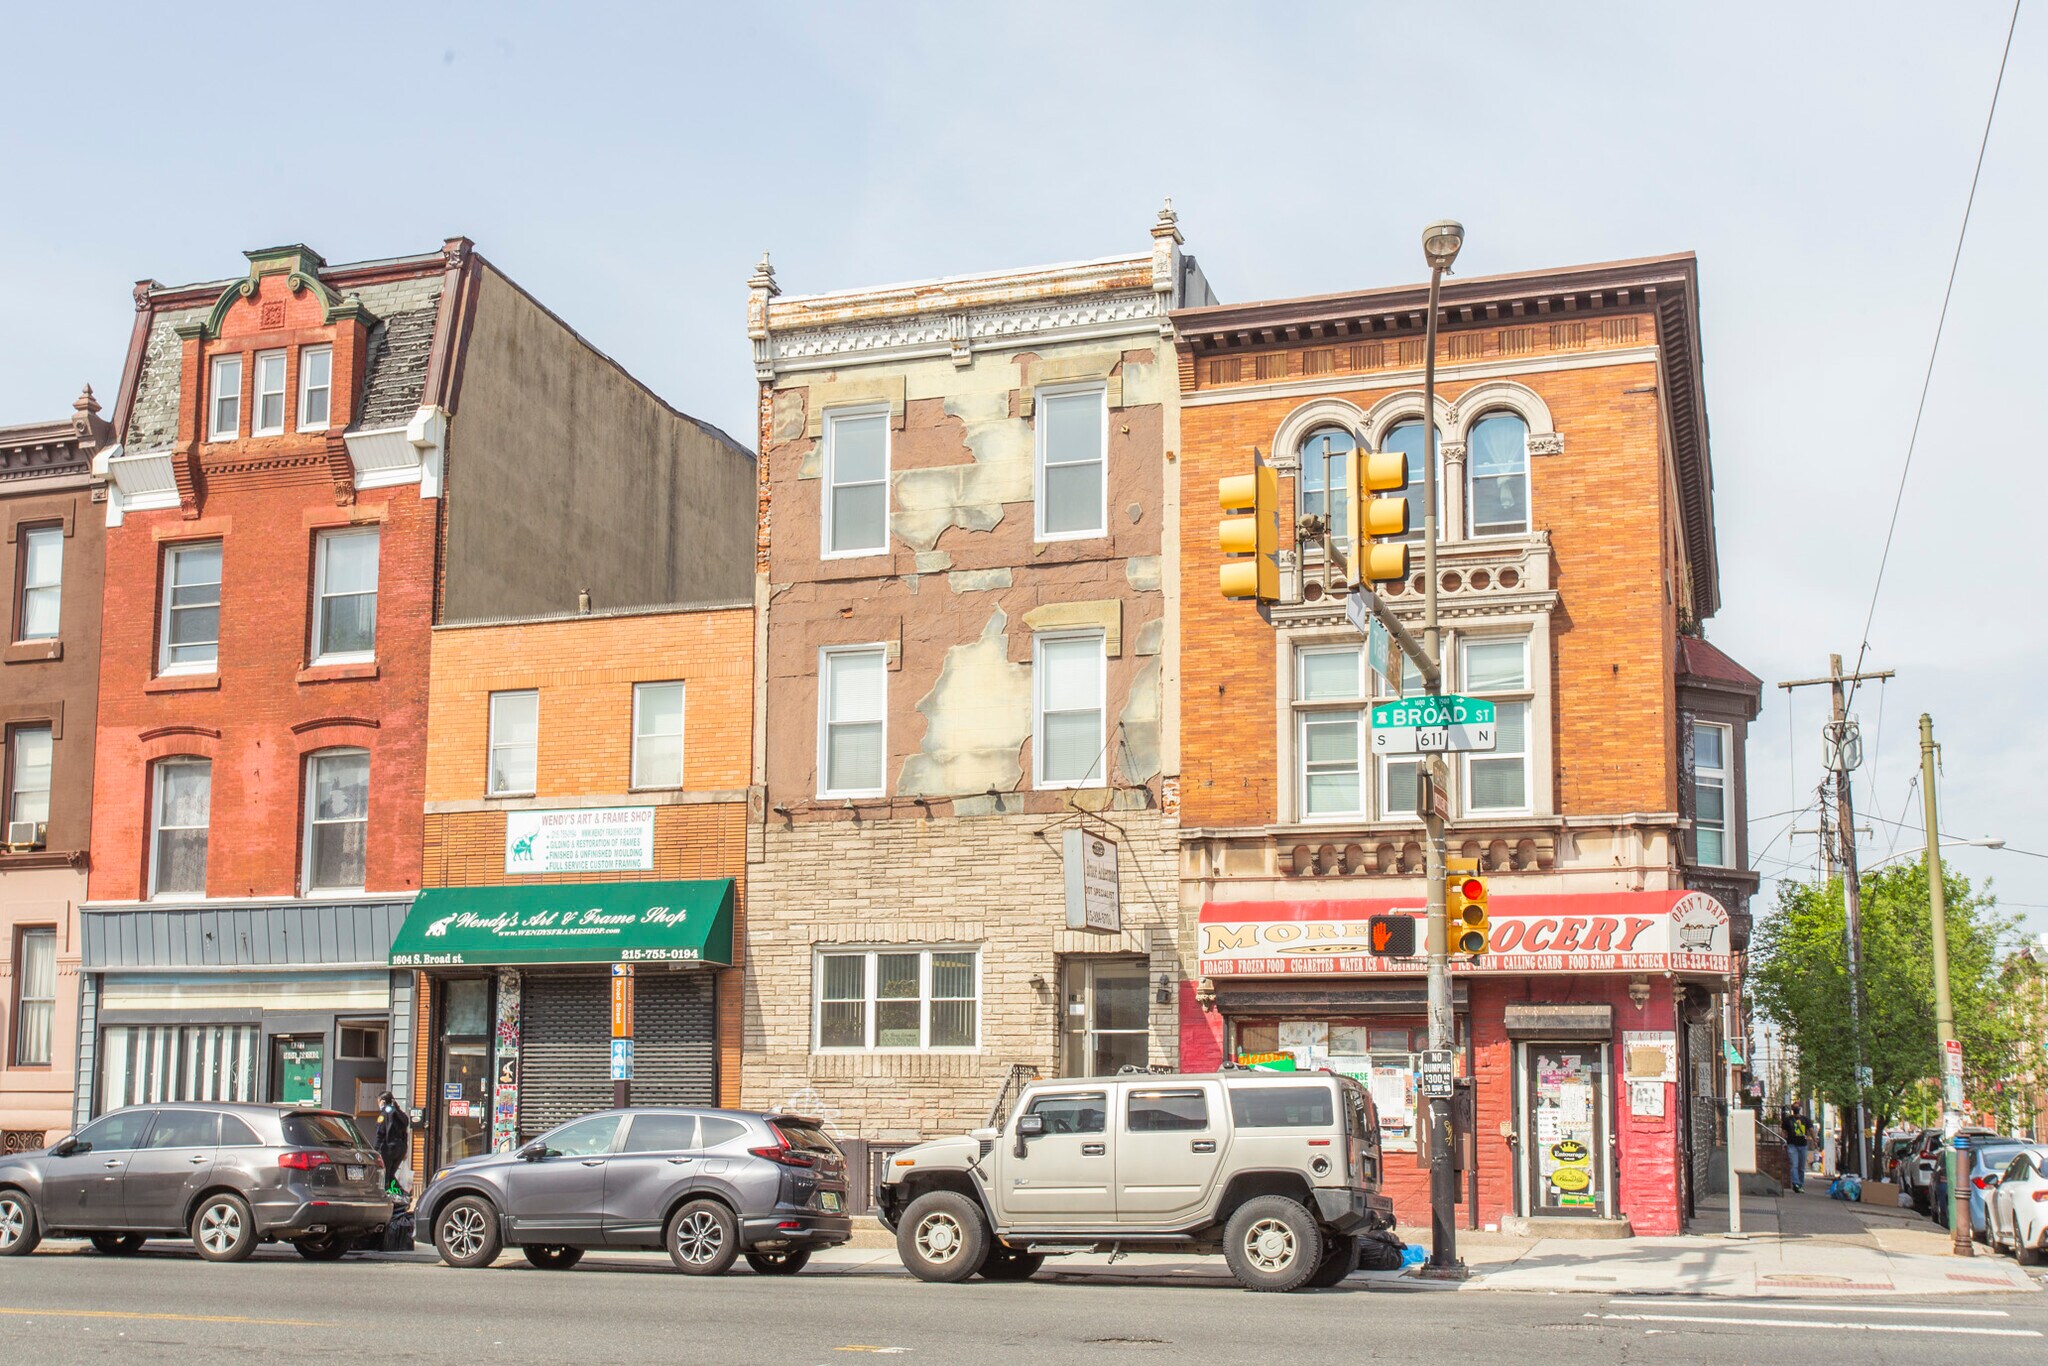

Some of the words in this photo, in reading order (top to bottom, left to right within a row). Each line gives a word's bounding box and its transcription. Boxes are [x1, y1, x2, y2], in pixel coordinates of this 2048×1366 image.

[1429, 698, 1435, 707] S
[1393, 706, 1467, 726] BROAD
[1475, 709, 1490, 722] ST
[1377, 735, 1386, 746] S
[1420, 732, 1442, 746] 611
[1479, 731, 1488, 741] N
[542, 814, 576, 826] WENDY'S
[576, 813, 593, 825] ART
[594, 813, 600, 824] &
[602, 812, 629, 824] FRAME
[630, 810, 652, 822] SHOP
[550, 841, 570, 850] GILDING
[576, 840, 611, 848] RESTORATION
[612, 839, 618, 847] OF
[620, 838, 640, 846] FRAMES
[550, 850, 574, 860] FINISHED
[580, 850, 612, 858] UNFINISHED
[614, 848, 643, 857] MOULDING
[549, 862, 563, 870] FULL
[564, 860, 588, 870] SERVICE
[590, 860, 614, 868] CUSTOM
[614, 859, 641, 868] FRAMING
[1672, 897, 1694, 923] OPEN
[1697, 896, 1703, 910] 7
[1706, 898, 1729, 926] DAYS
[456, 912, 519, 933] Wendy's
[522, 910, 559, 927] Art
[561, 912, 578, 926] &
[579, 908, 636, 925] Frame
[640, 906, 687, 928] Shop
[498, 927, 620, 936] www.WENDYSFRAMESHOP.com
[1424, 916, 1654, 953] OCERY
[392, 955, 412, 965] 1604
[413, 954, 422, 964] S.
[424, 954, 450, 964] Broad
[452, 953, 464, 964] st.
[621, 949, 698, 960] 215-755-0194
[1204, 960, 1234, 974] HOAGIES
[1238, 959, 1266, 974] FROZEN
[1266, 958, 1285, 973] FOOD
[1290, 958, 1334, 973] CIGARETTES
[1339, 958, 1364, 972] WATER
[1365, 957, 1378, 972] ICE
[1504, 956, 1536, 970] CALLING
[1538, 954, 1562, 970] CARDS
[1568, 954, 1589, 969] FOOD
[1590, 954, 1616, 969] STAMP
[1622, 954, 1638, 968] WIC
[1639, 953, 1664, 968] CHECK
[1672, 953, 1730, 972] 215-334-1293
[1431, 1052, 1442, 1062] NO
[1424, 1063, 1450, 1074] DUMPING
[451, 1106, 467, 1114] OPEN
[1554, 1150, 1586, 1158] Entourage
